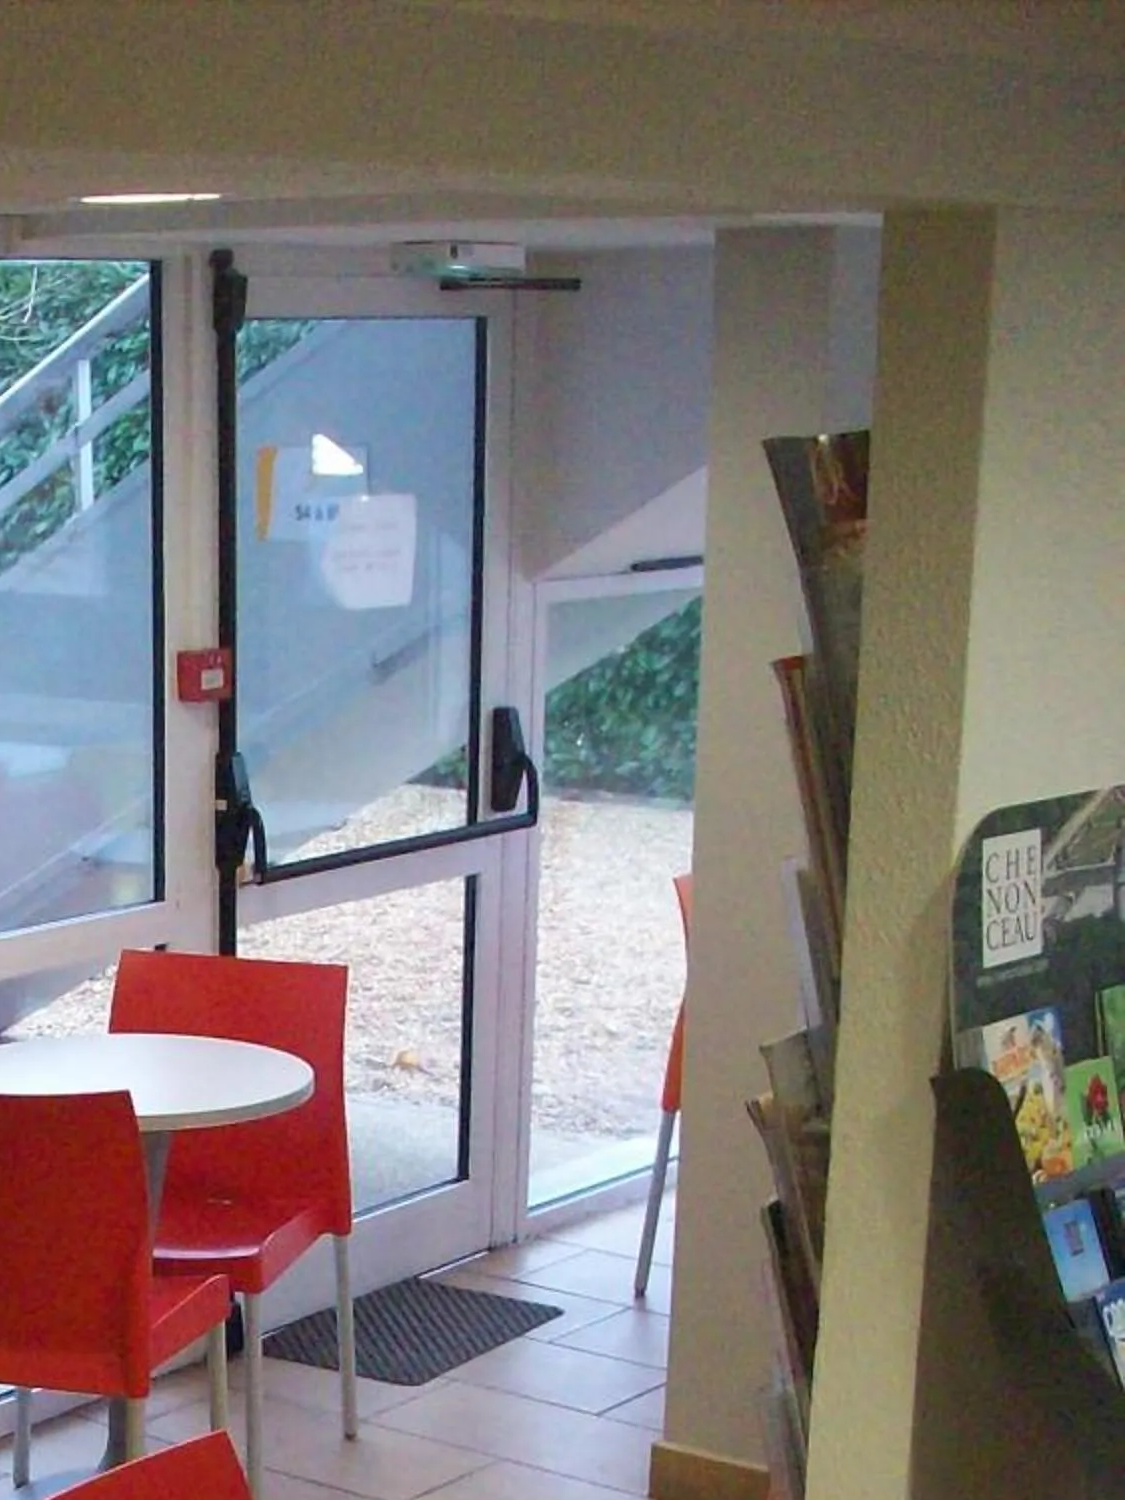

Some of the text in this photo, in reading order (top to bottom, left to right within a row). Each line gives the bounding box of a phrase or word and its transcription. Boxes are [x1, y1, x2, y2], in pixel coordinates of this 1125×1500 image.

[985, 845, 1037, 884] CHE
[986, 880, 1038, 918] NON
[986, 911, 1038, 950] CEAU
